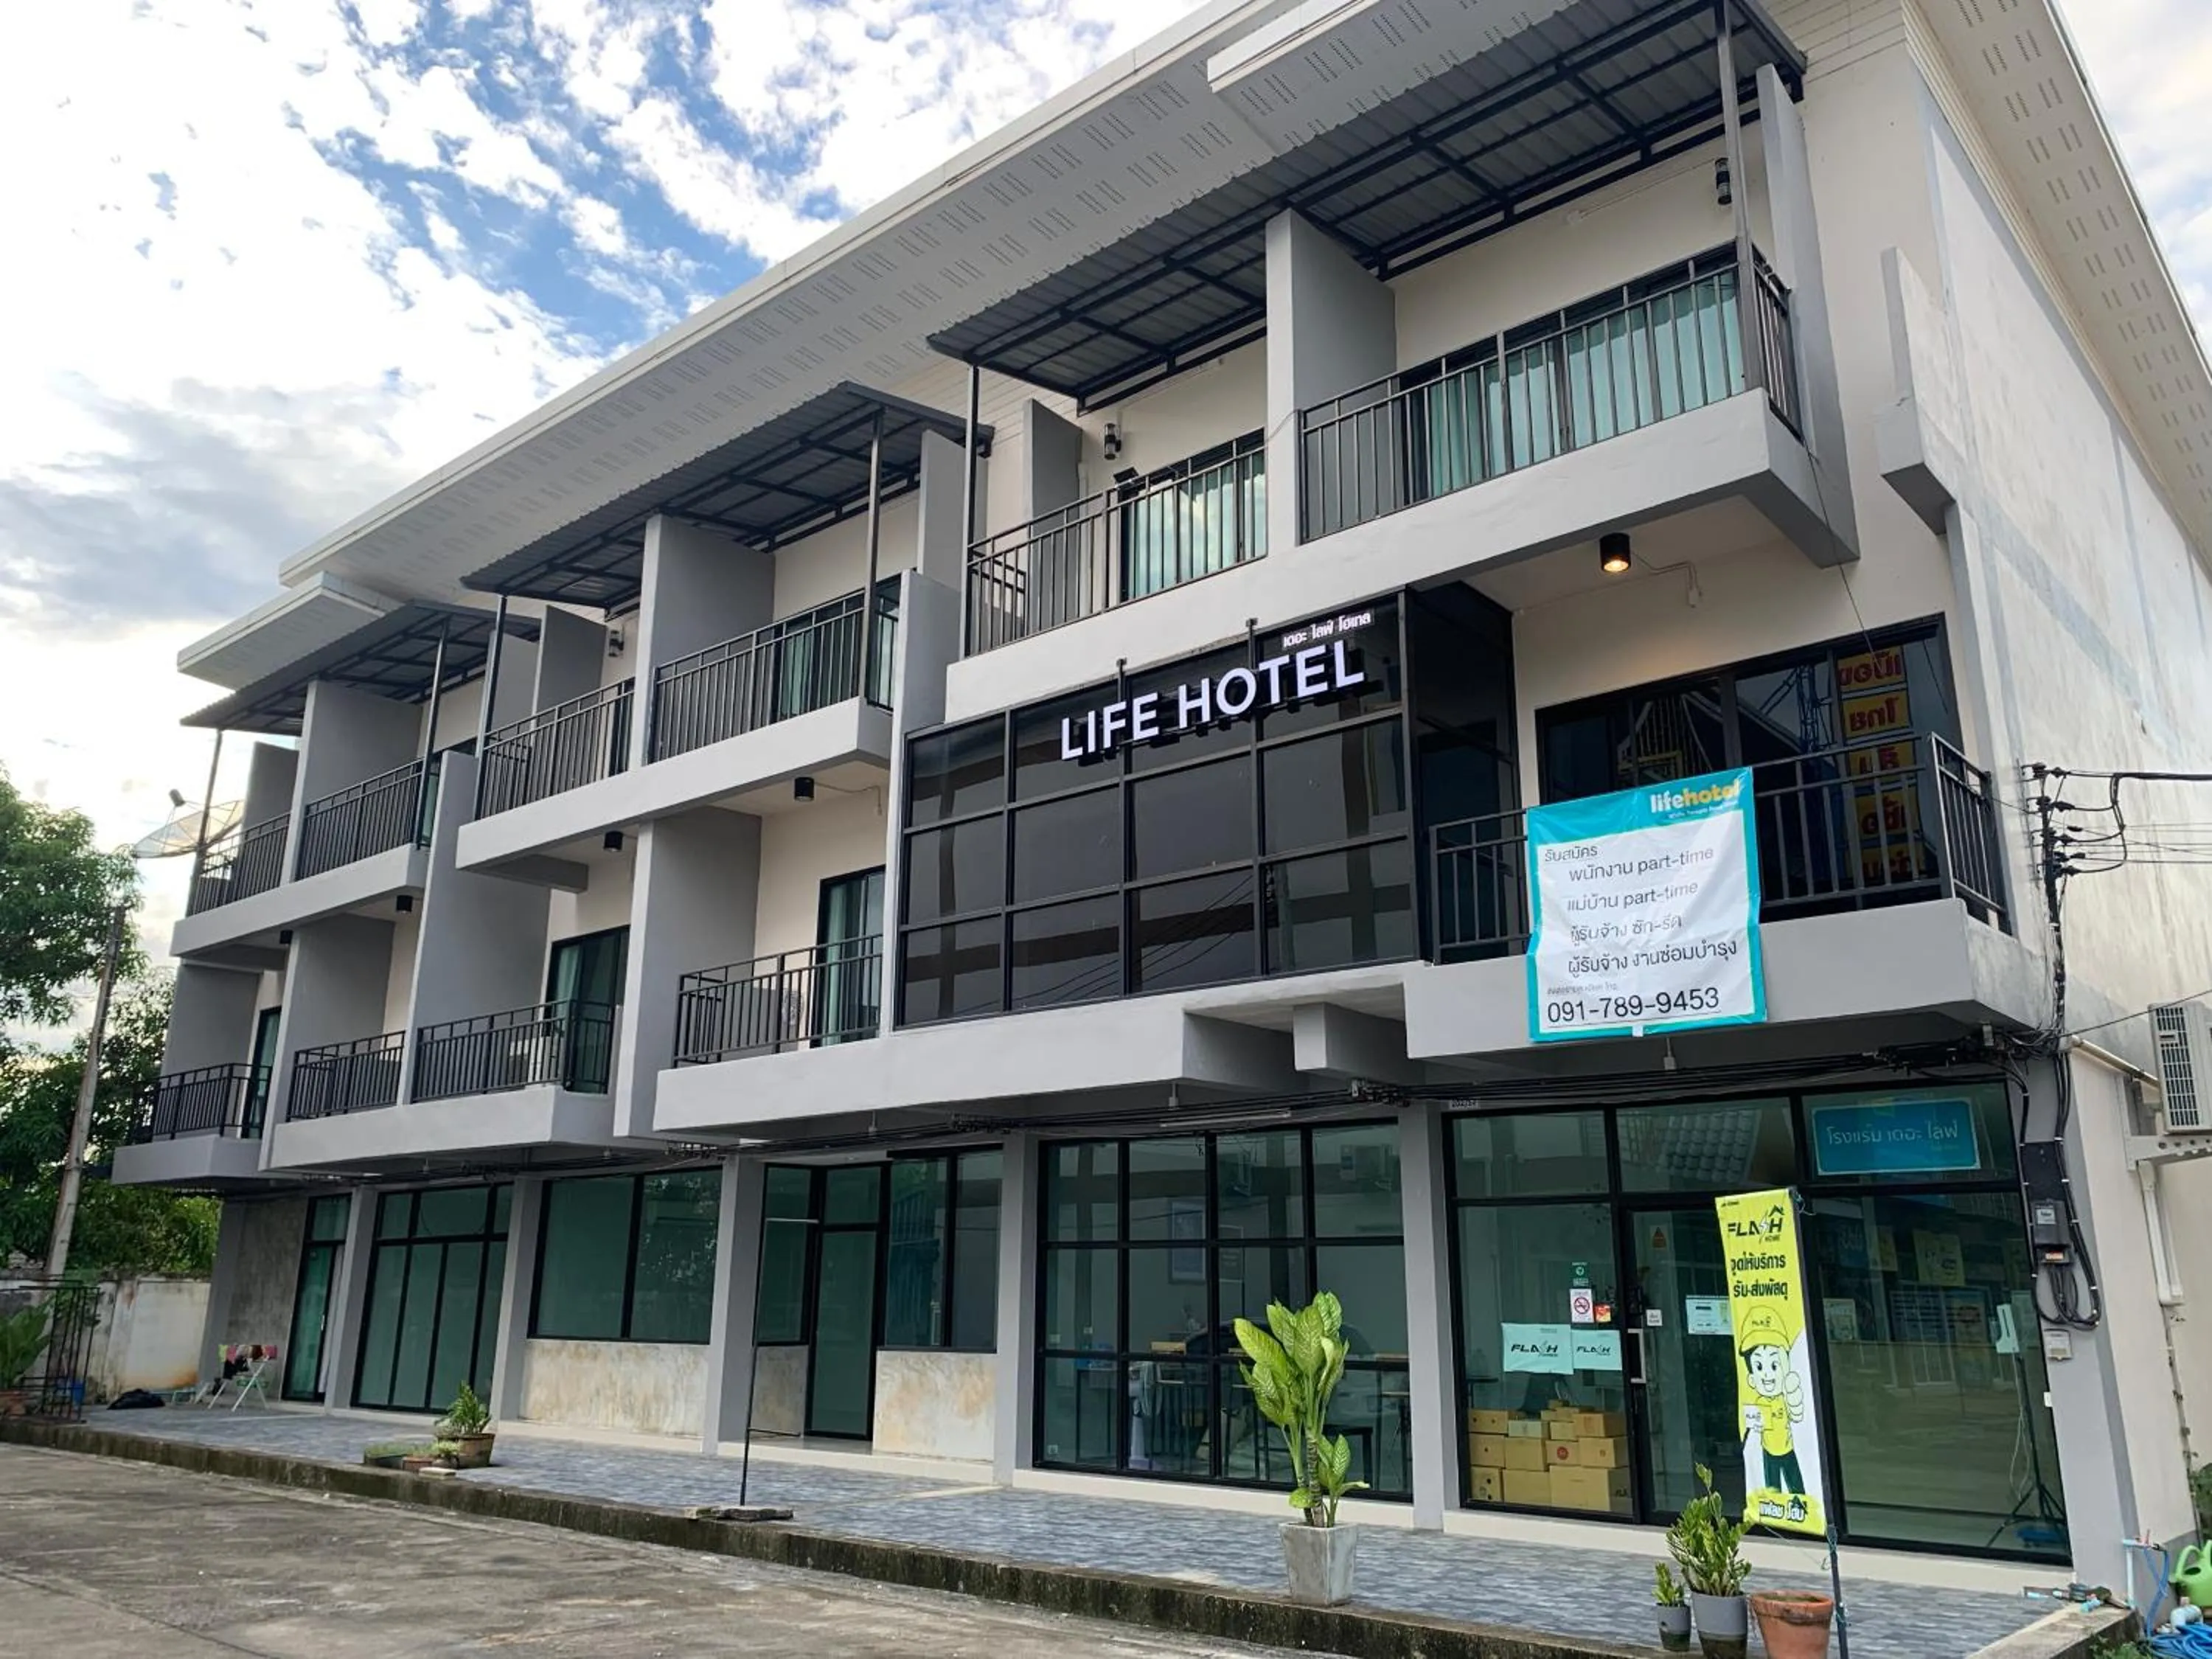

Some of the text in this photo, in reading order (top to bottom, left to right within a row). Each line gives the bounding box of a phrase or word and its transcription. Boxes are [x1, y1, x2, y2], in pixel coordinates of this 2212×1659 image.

[1061, 640, 1366, 760] LIFE HOTEL
[1545, 845, 1599, 863] รับสมัคร
[1569, 847, 1714, 883] พนักงาน part-time
[1567, 883, 1699, 911] แม่บ้าน part-time
[1548, 987, 1719, 1023] 091-789-9453
